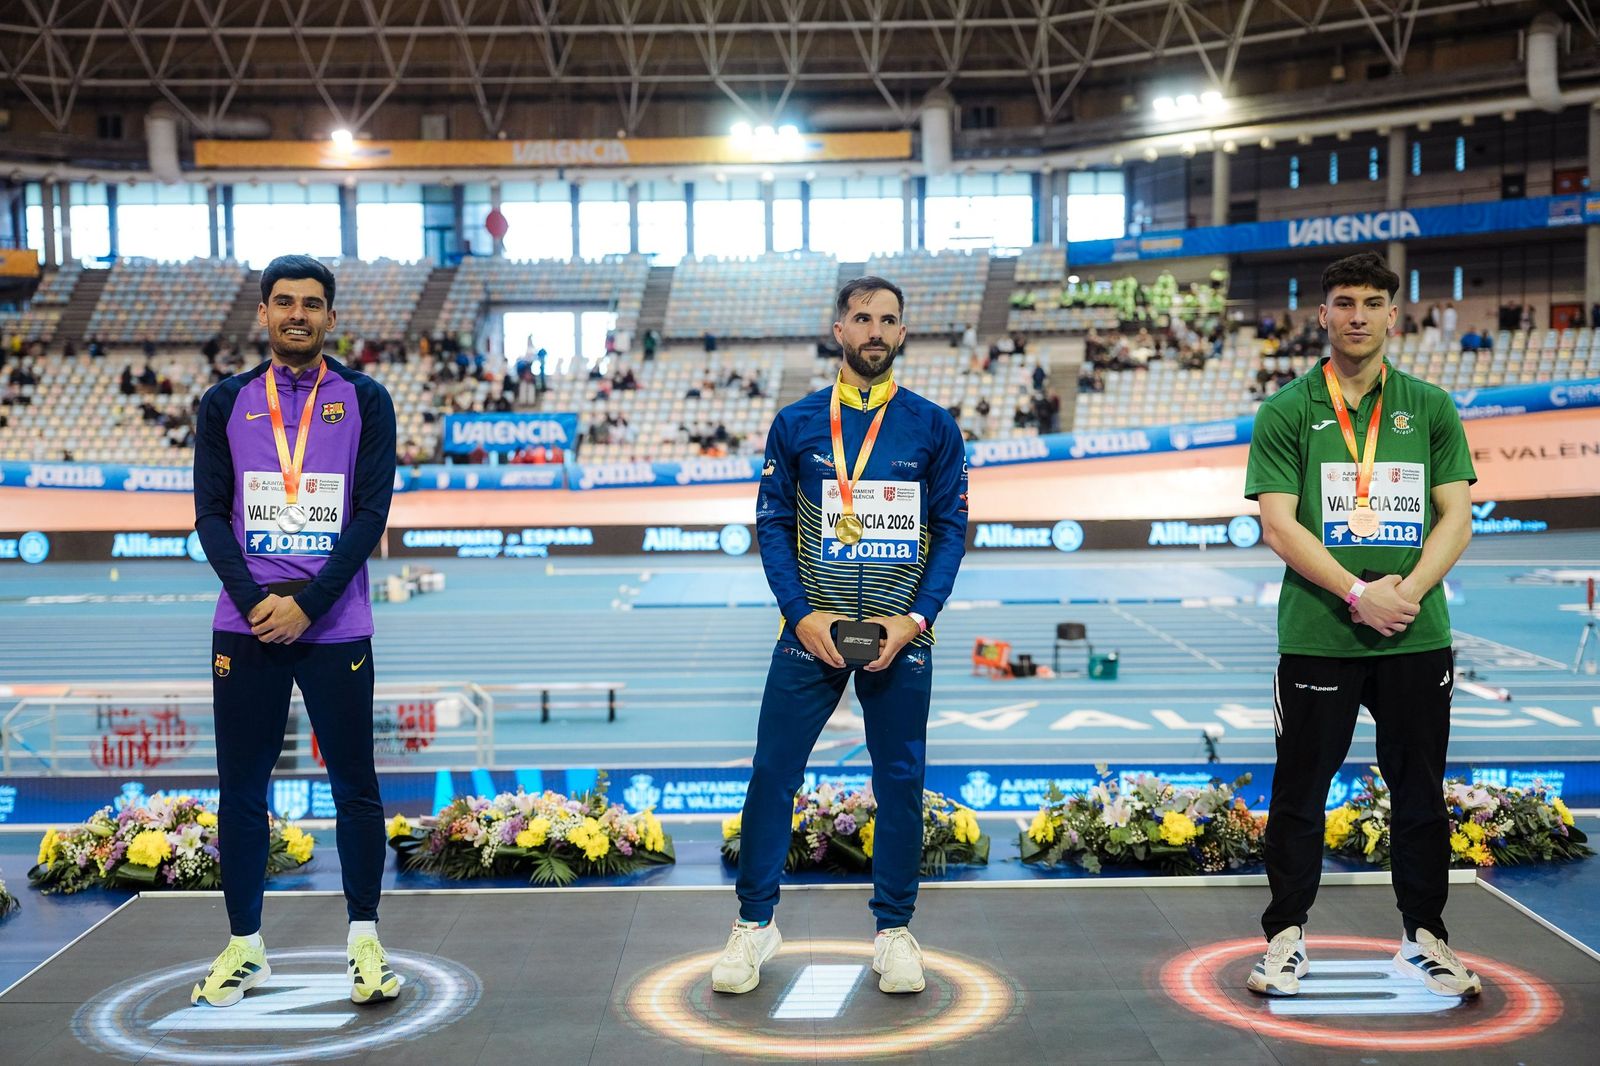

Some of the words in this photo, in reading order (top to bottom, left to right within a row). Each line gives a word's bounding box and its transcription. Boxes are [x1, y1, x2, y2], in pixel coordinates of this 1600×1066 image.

[1288, 210, 1420, 247] VALENCIA
[452, 420, 569, 445] VALENCIA
[308, 506, 338, 523] 2026
[1327, 496, 1392, 512] VALECIA
[1393, 496, 1421, 513] 2026
[827, 513, 885, 530] VANCIA
[887, 515, 916, 531] 2026
[1148, 521, 1229, 546] Allianz
[112, 532, 188, 558] Allianz
[642, 526, 721, 552] Allianz
[973, 523, 1052, 547] Allianz
